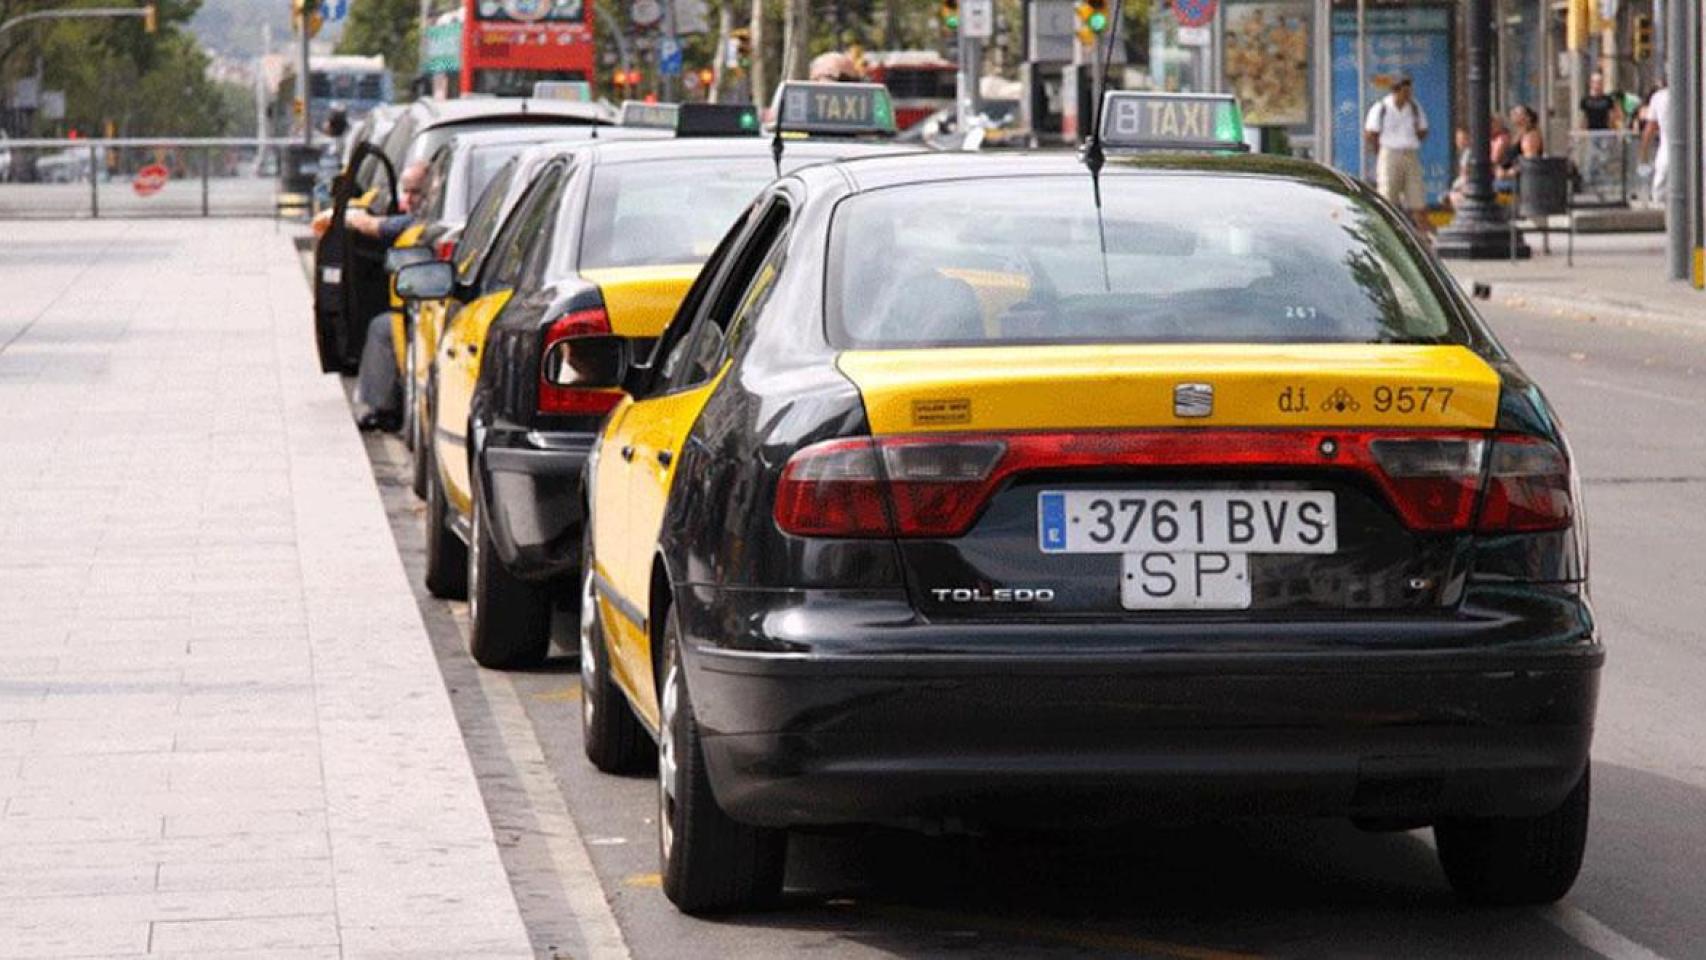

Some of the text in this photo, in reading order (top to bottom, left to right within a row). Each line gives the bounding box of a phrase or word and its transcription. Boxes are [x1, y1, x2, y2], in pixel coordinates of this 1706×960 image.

[815, 93, 867, 119] TAXI
[1146, 101, 1210, 136] TAXI
[1374, 385, 1454, 413] 9577
[1089, 500, 1204, 544] 3761
[1228, 500, 1325, 545] BVS
[931, 588, 1055, 601] TOLEDO
